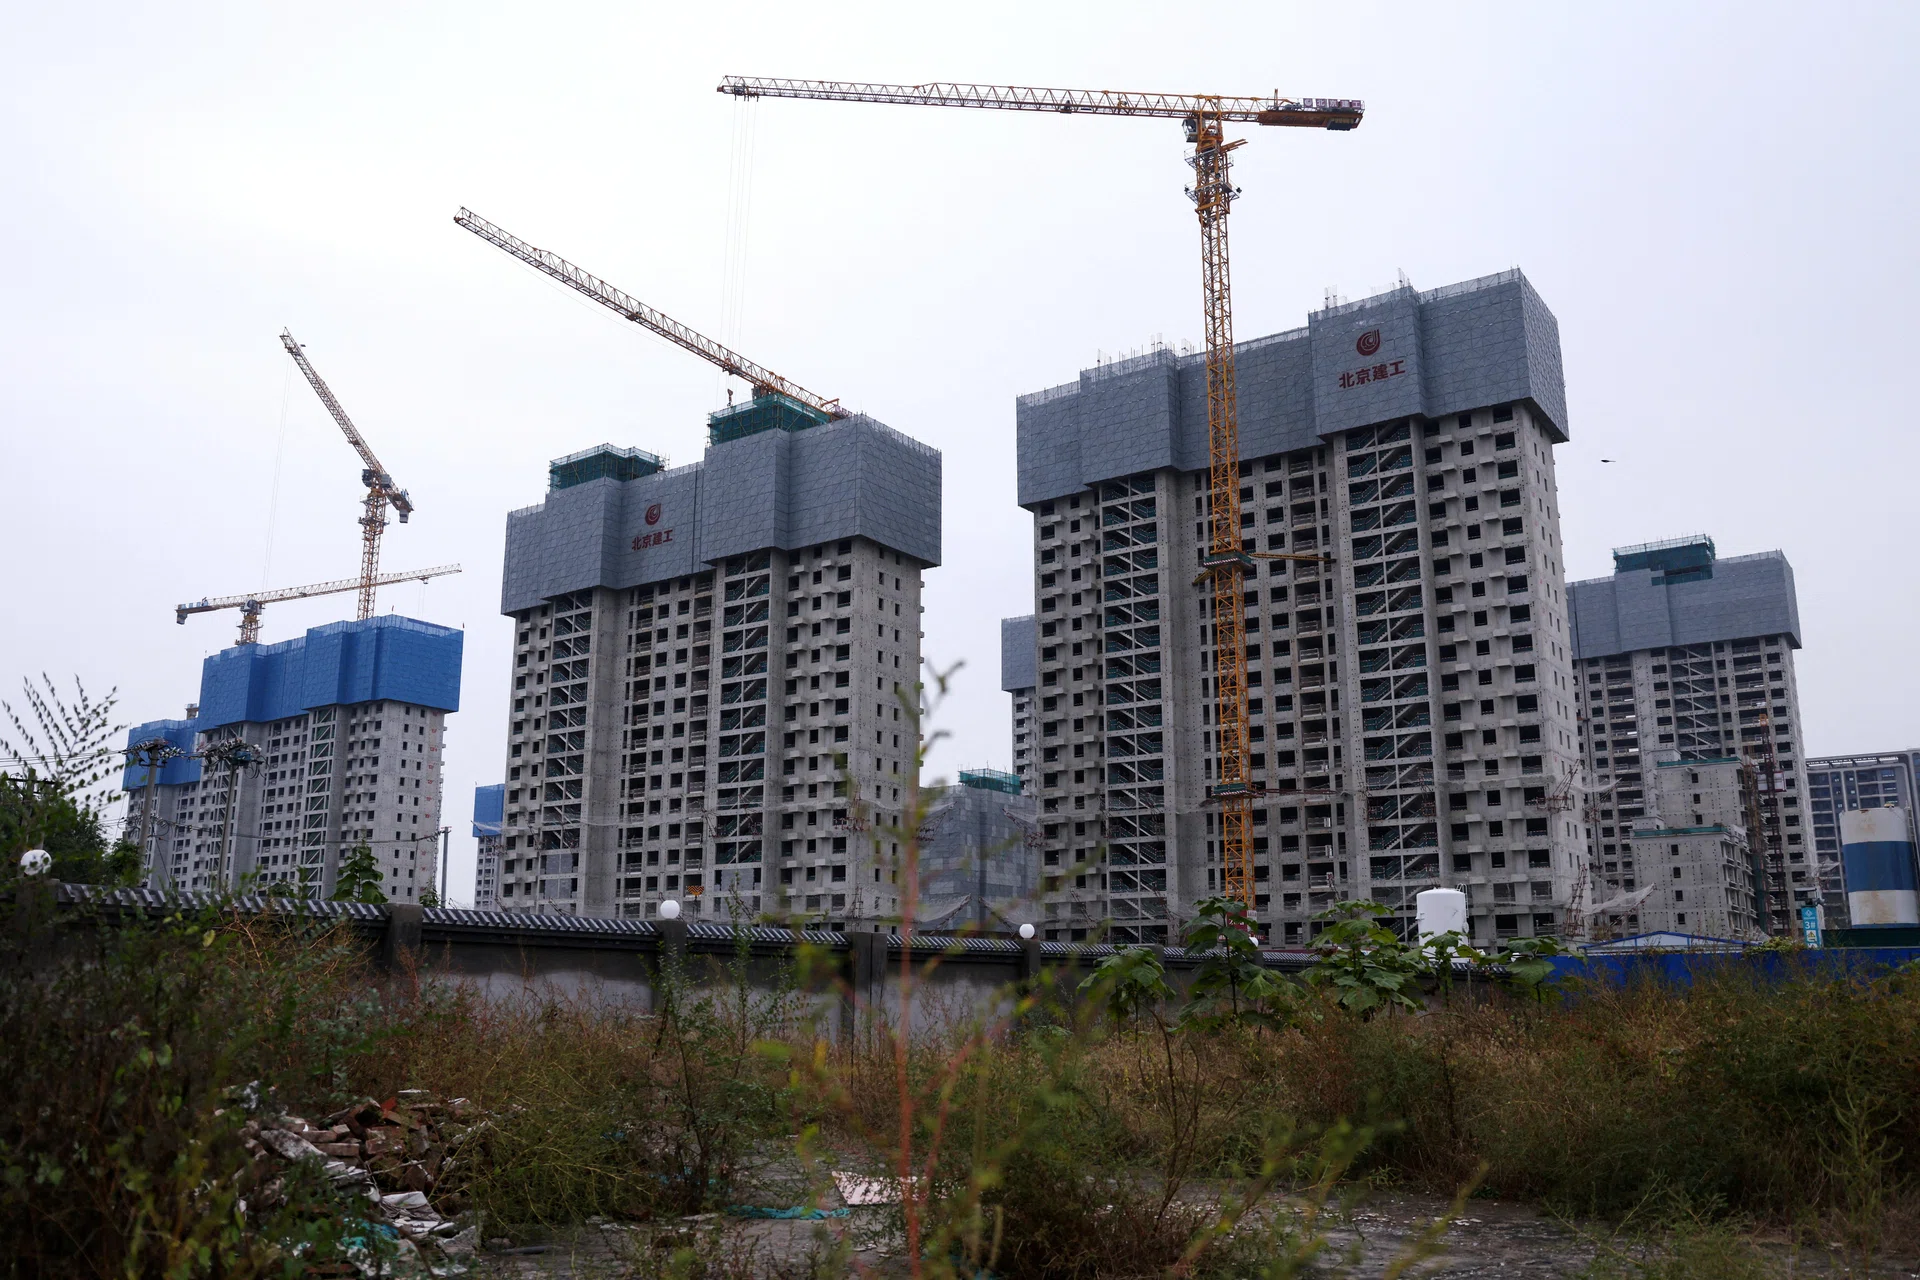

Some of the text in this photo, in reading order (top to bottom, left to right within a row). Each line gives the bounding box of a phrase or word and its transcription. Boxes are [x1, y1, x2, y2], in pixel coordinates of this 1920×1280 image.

[1316, 99, 1361, 108] 北京建工
[1338, 359, 1406, 389] 北京建工
[631, 529, 673, 551] 北京建工
